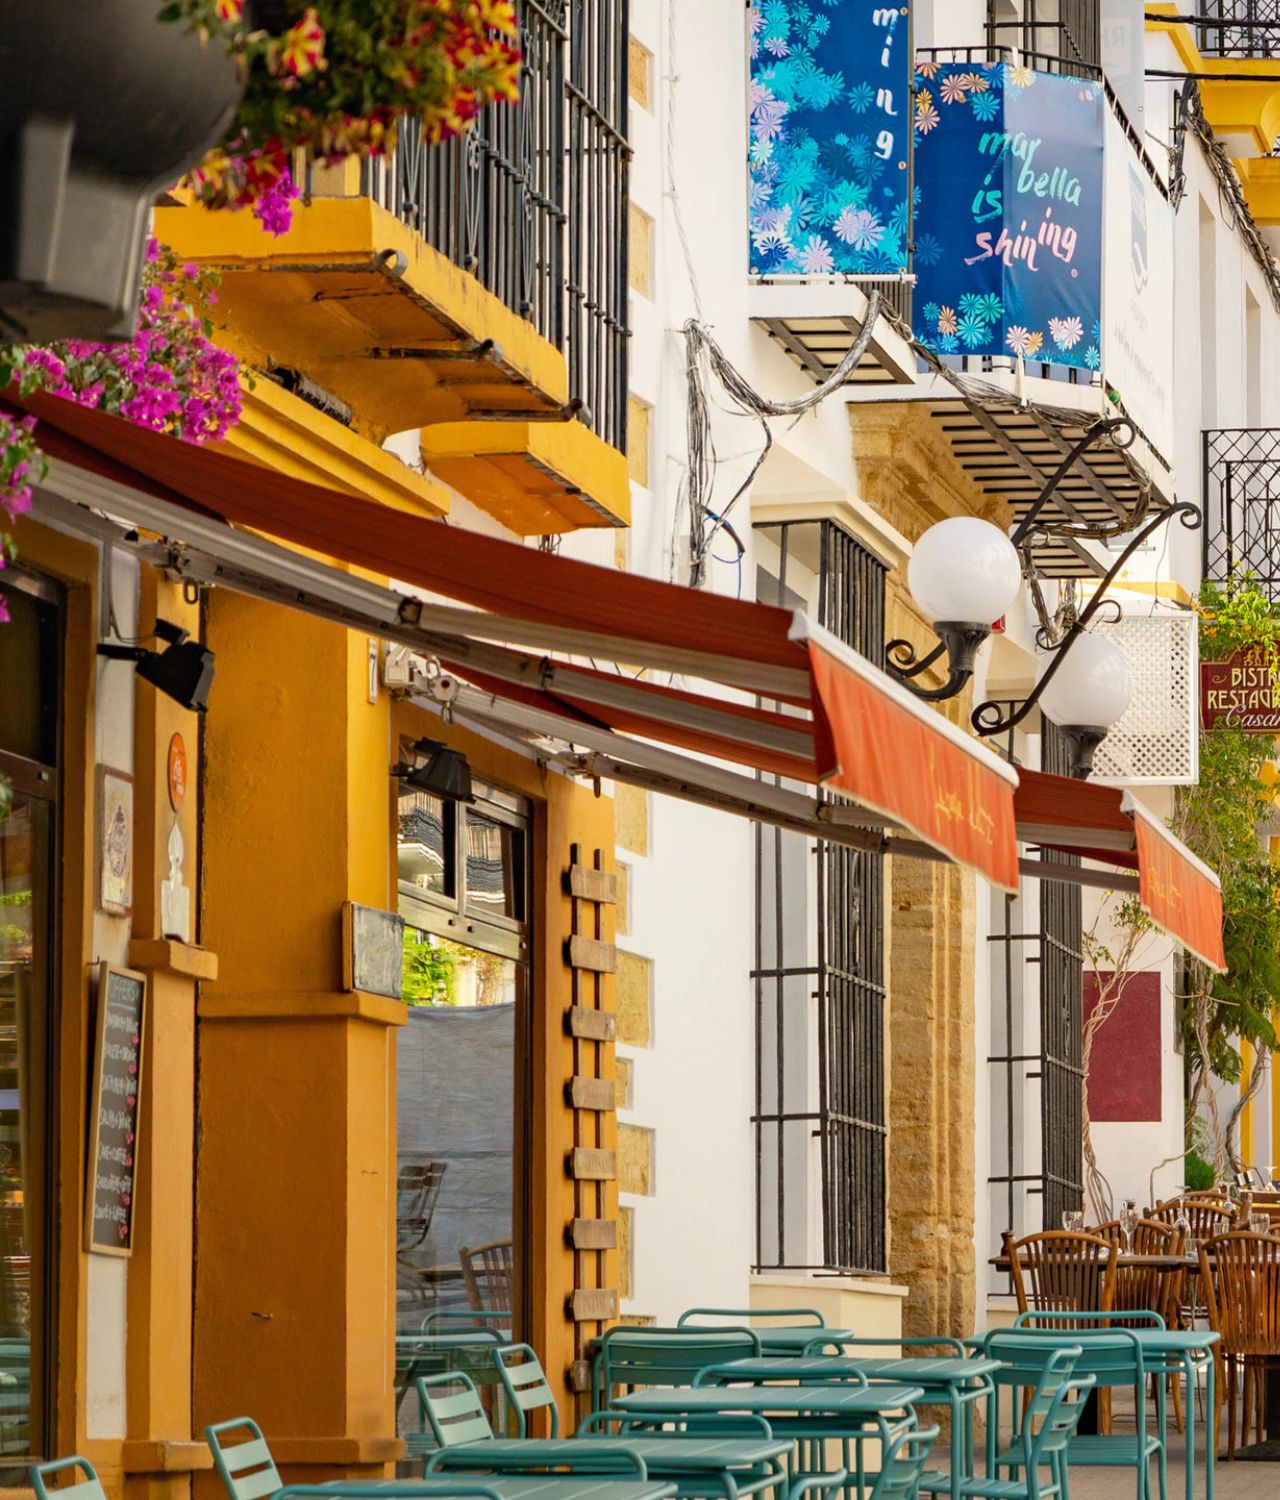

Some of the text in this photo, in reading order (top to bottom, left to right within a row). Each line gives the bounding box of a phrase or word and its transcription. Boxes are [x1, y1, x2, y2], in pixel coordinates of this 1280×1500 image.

[978, 131, 1042, 166] mar
[971, 173, 1003, 223] is
[1016, 164, 1082, 207] bella
